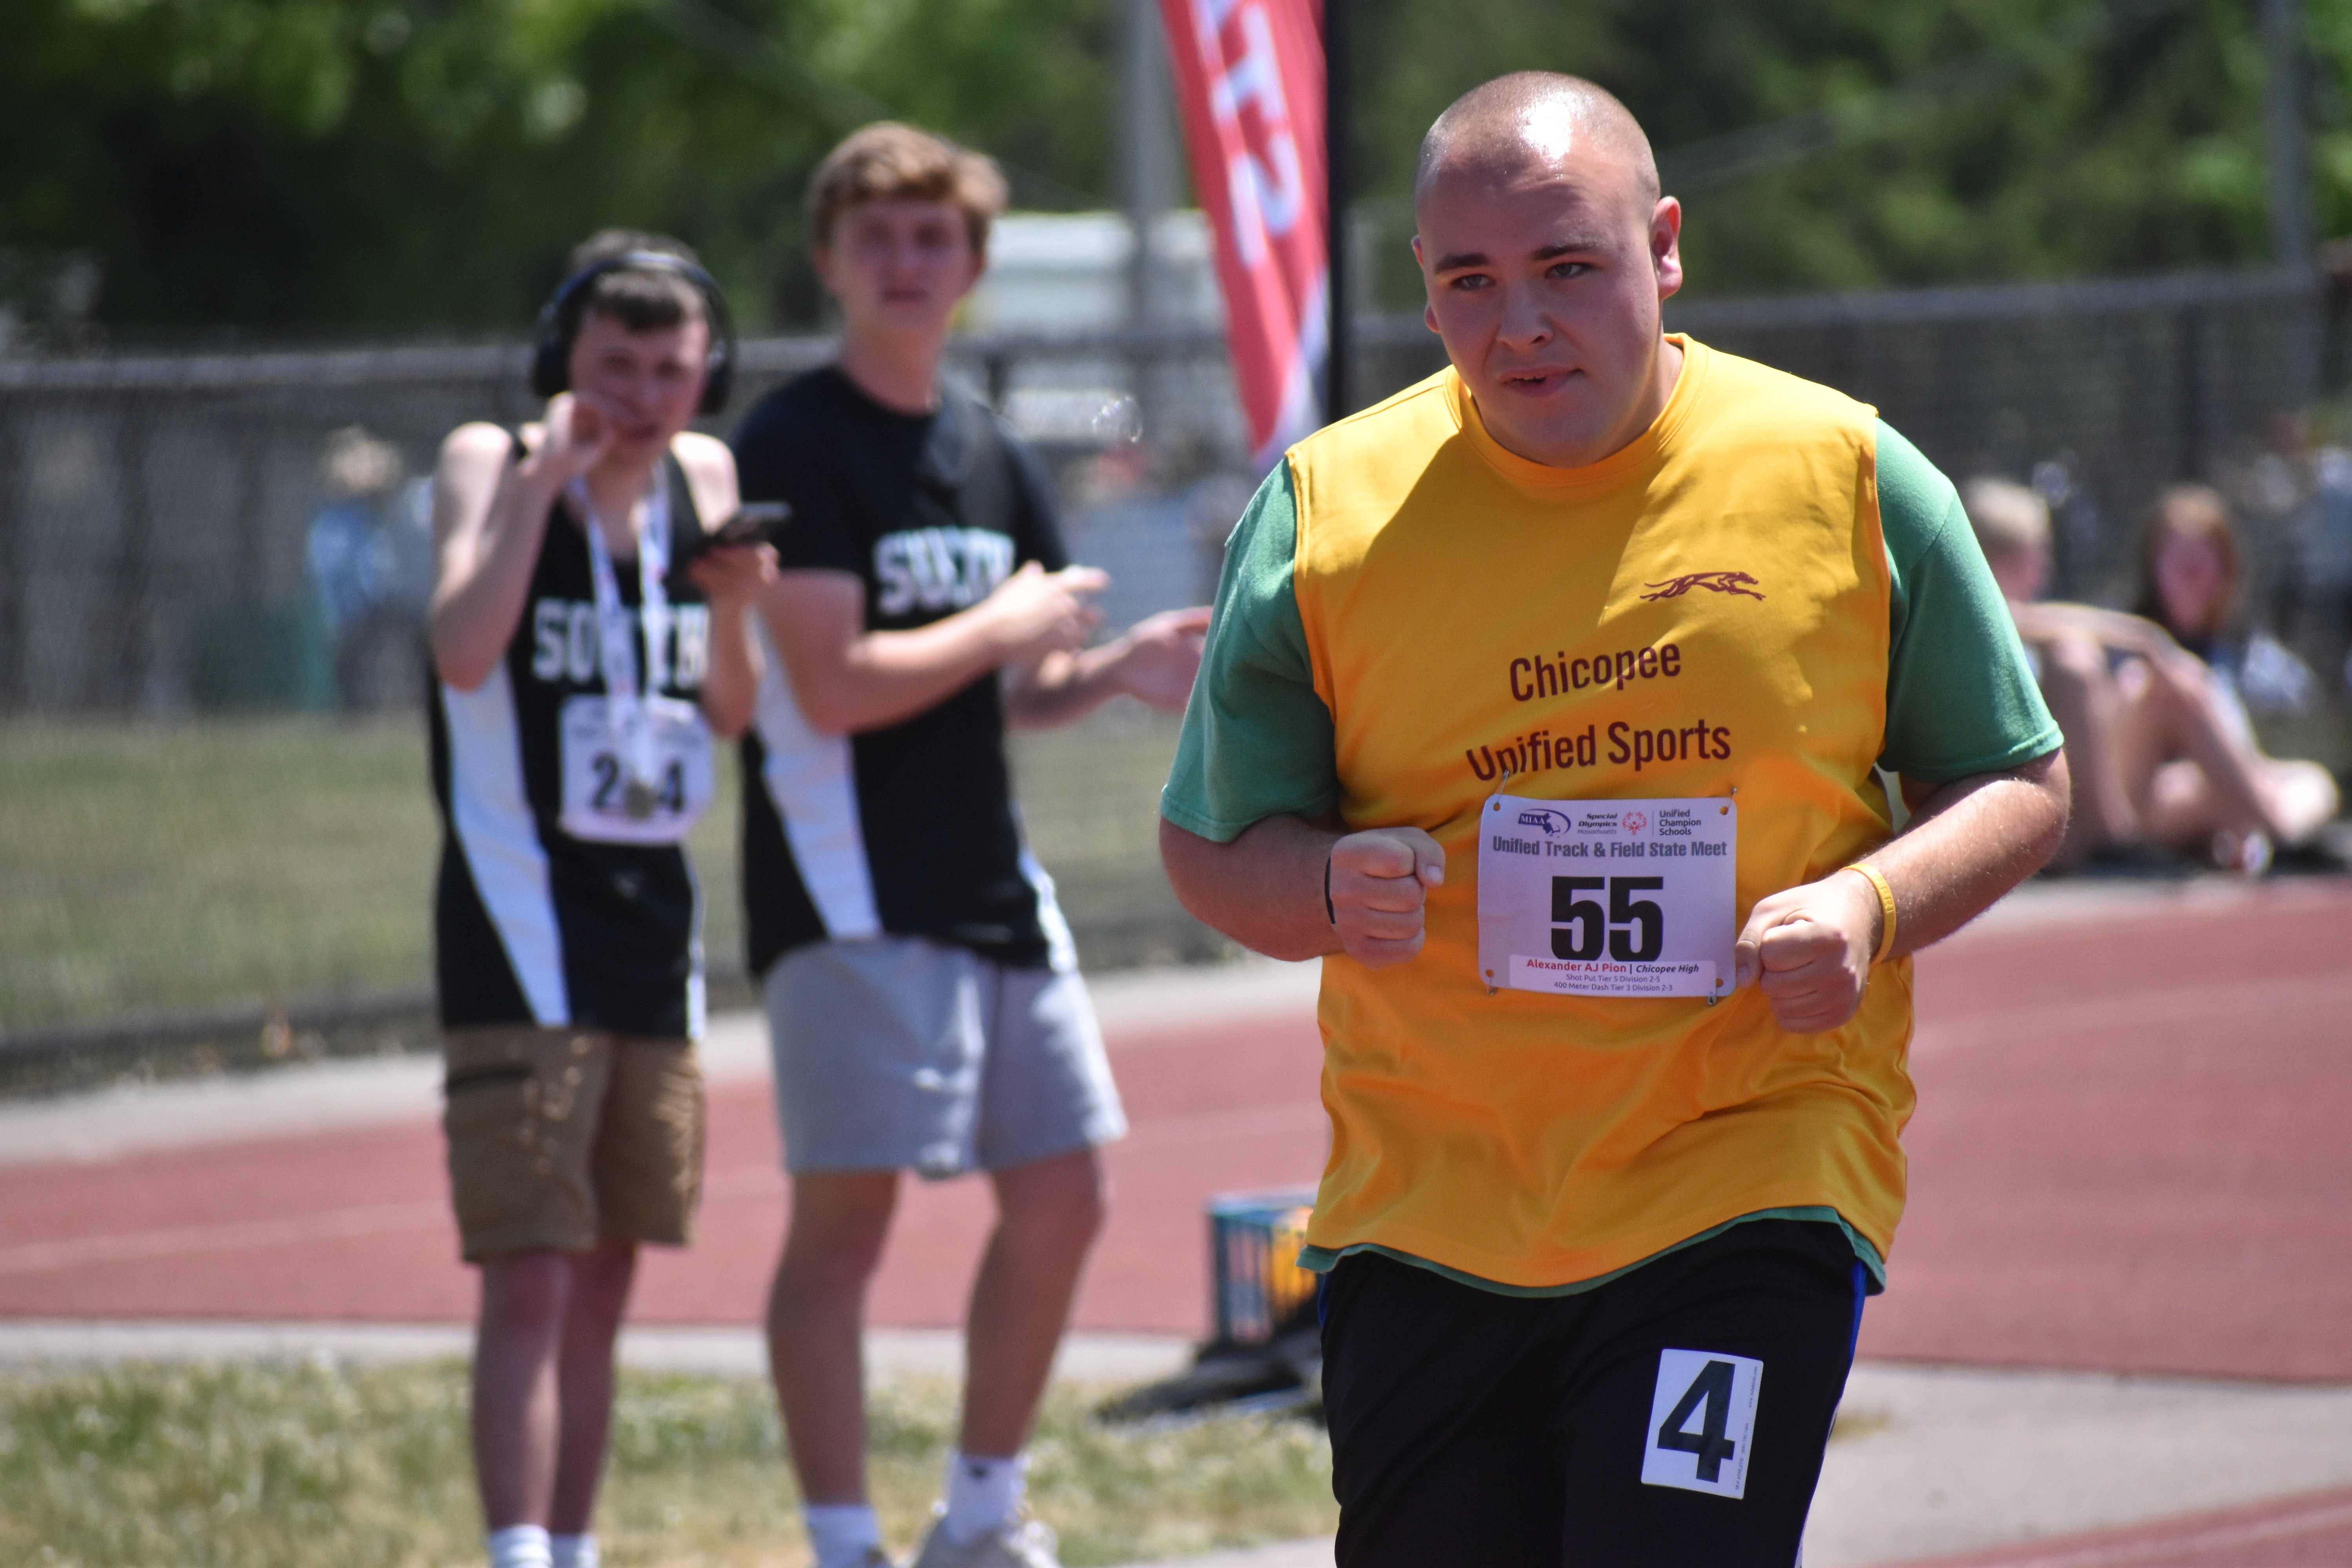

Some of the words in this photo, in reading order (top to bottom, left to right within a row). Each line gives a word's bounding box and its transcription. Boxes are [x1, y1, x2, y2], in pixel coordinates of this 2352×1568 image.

[1510, 642, 1681, 702] Chicopee
[1466, 724, 1597, 781] Unified
[1608, 719, 1731, 772] Sports
[1521, 815, 1545, 824] MIAA
[1659, 809, 1690, 817] Unified
[1659, 818, 1701, 827] Champion
[1493, 835, 1540, 855] Unified
[1545, 841, 1589, 857] Track
[1594, 842, 1606, 857] &
[1611, 842, 1645, 857] Field
[1650, 842, 1687, 857] State
[1691, 842, 1727, 856] Meet
[1551, 876, 1664, 962] 55
[1527, 959, 1582, 971] Alexander
[1585, 963, 1599, 972] AJ
[1602, 963, 1626, 972] Pion
[1636, 964, 1676, 974] Chicopee
[1679, 964, 1699, 974] High
[1657, 1360, 1735, 1483] 4
